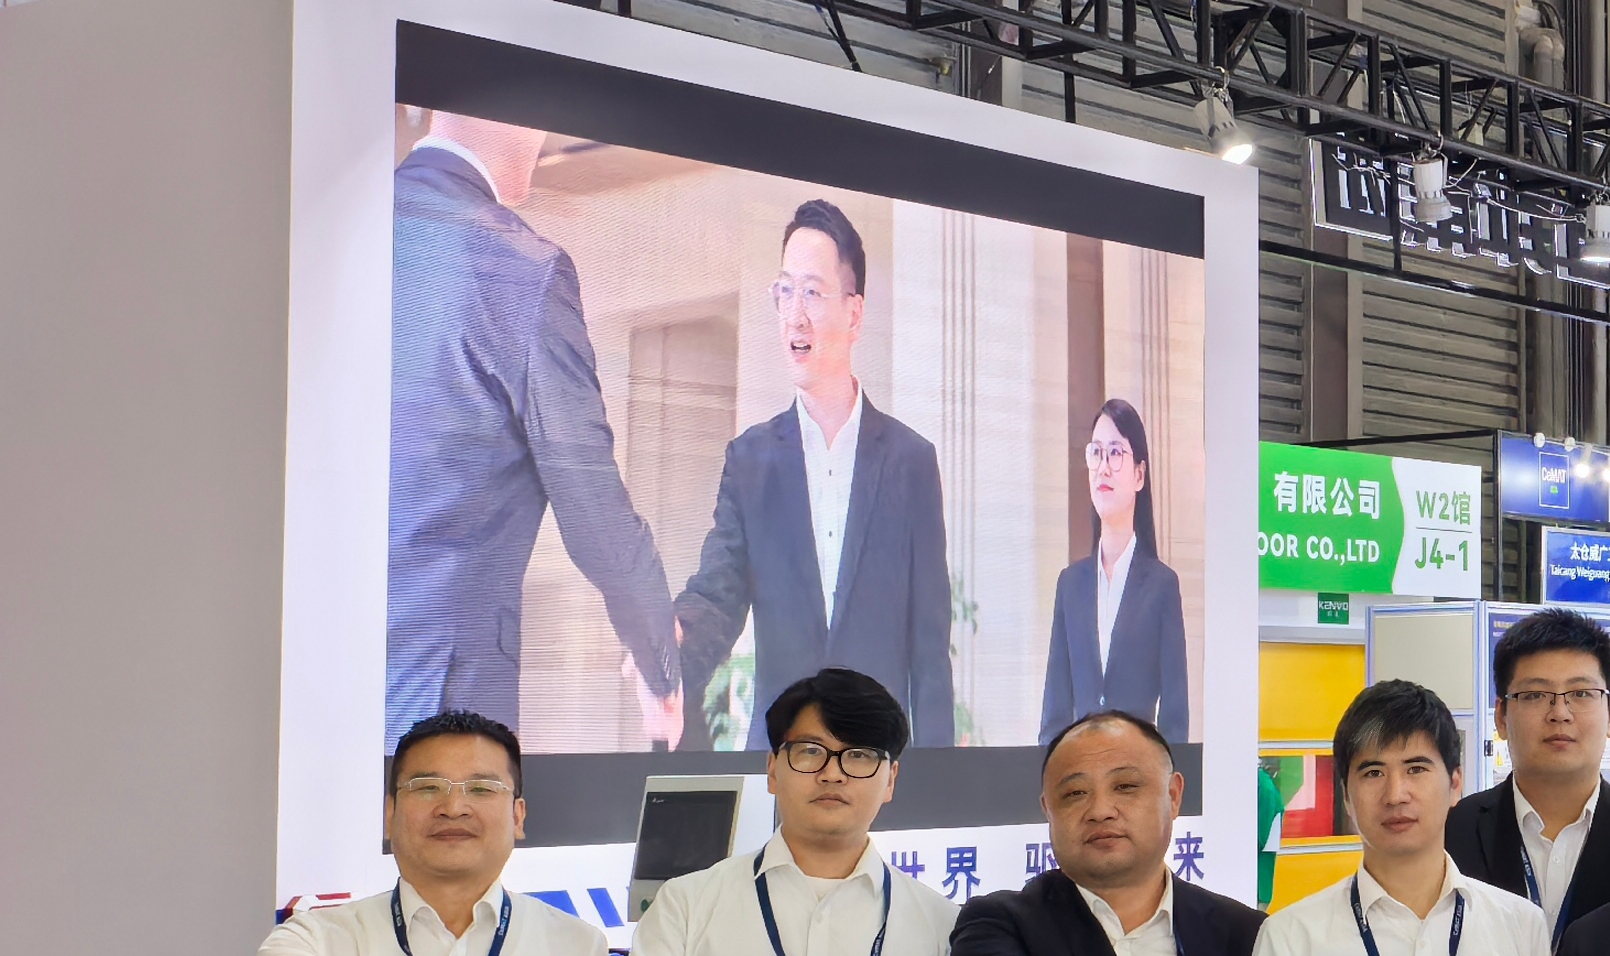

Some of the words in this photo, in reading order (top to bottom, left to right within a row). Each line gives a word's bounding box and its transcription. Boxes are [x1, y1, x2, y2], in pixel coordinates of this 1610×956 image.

[1541, 467, 1567, 484] CeMAT
[1273, 471, 1380, 520] 有限公司
[1415, 490, 1471, 525] W2馆
[1306, 535, 1380, 566] CO.,LTD
[1414, 537, 1468, 571] J4-1
